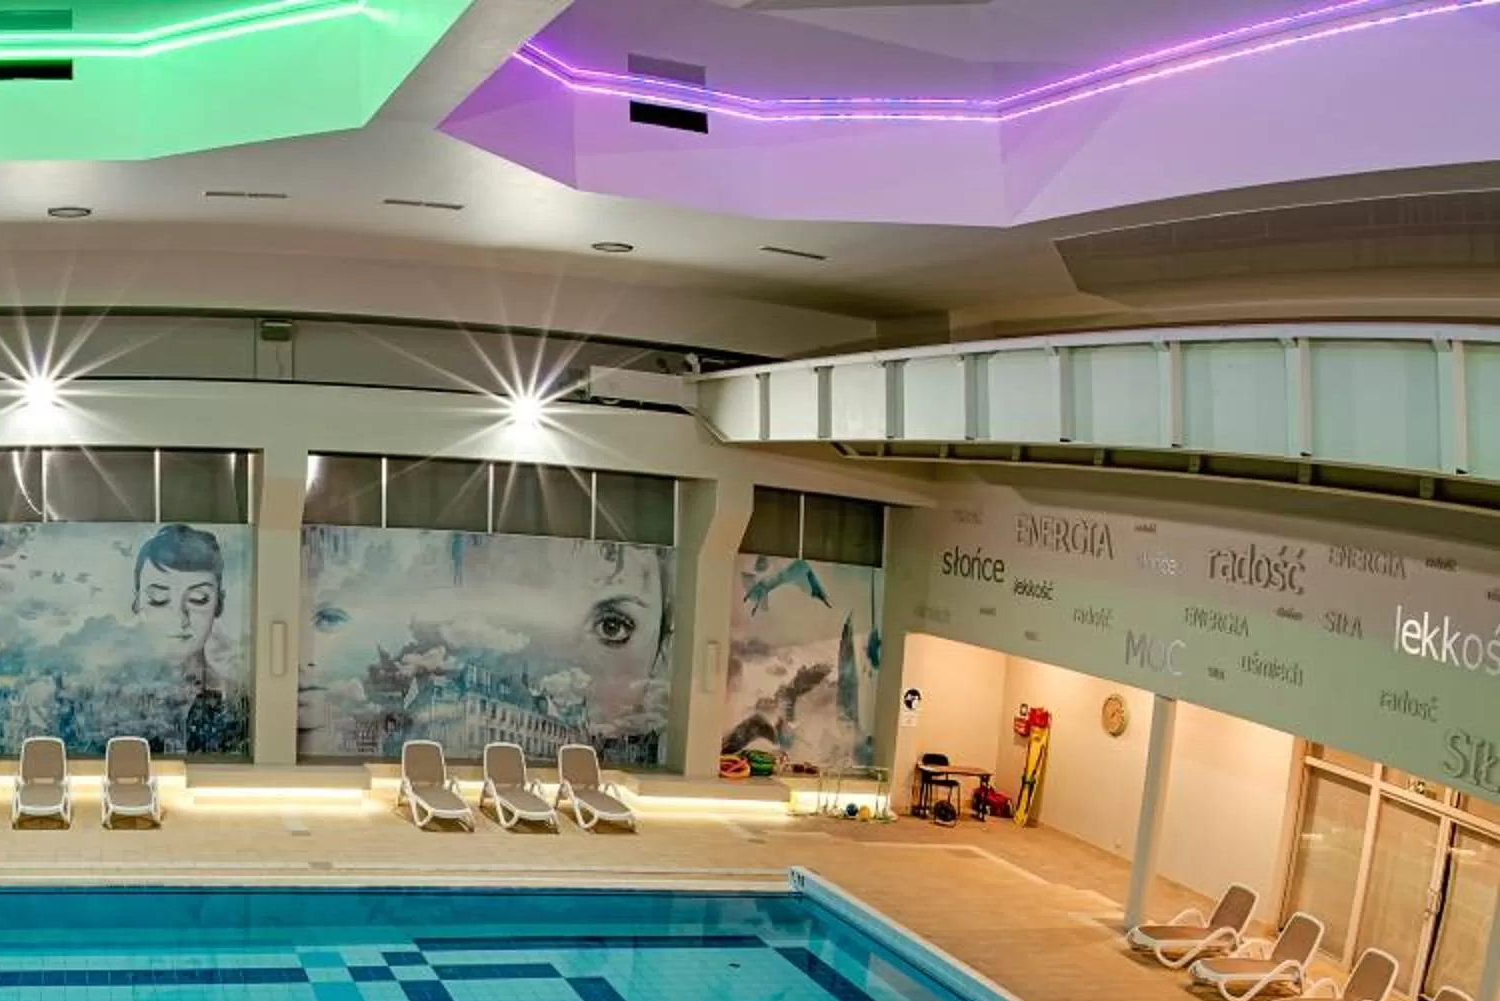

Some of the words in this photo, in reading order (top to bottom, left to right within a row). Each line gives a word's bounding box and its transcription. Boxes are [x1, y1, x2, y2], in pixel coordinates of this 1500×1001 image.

[1016, 513, 1115, 560] ENERGIA
[941, 545, 1005, 583] słońce
[1208, 543, 1306, 595] radość
[1125, 629, 1188, 677] MOC
